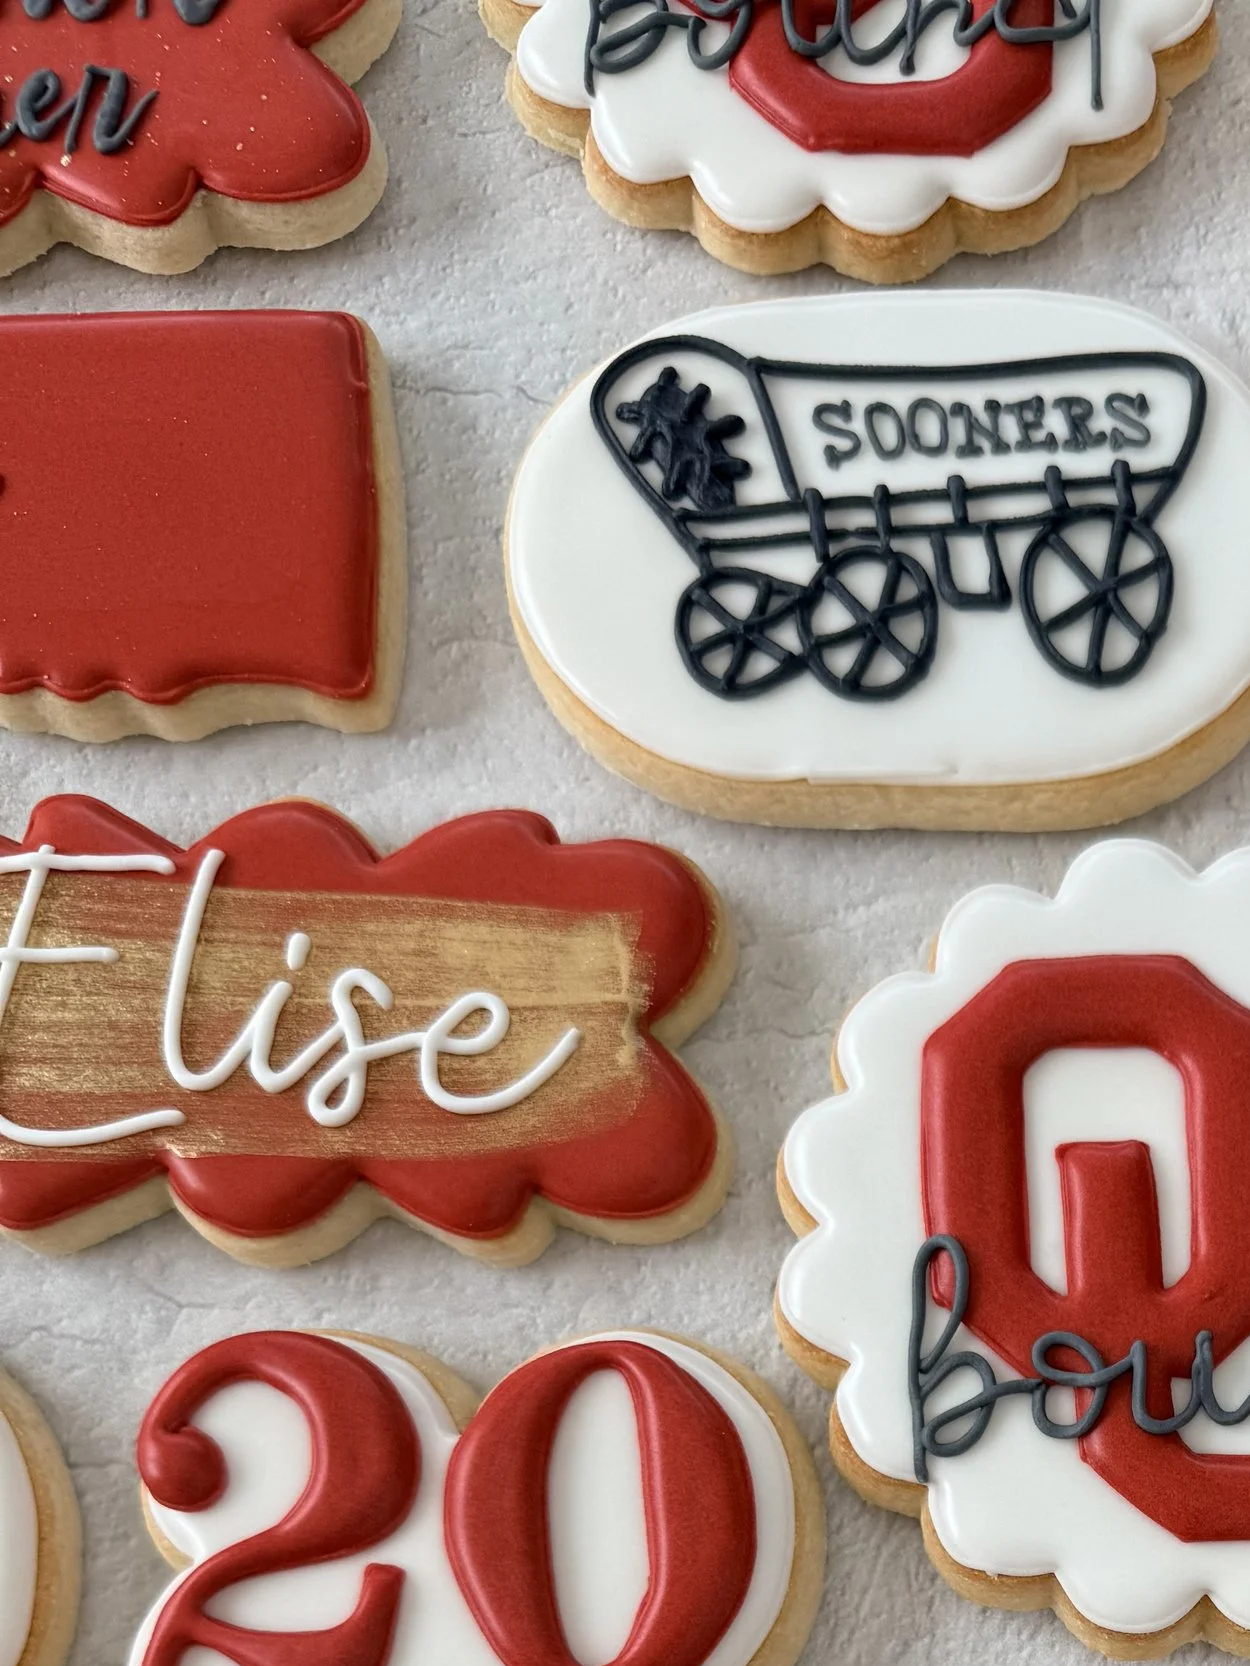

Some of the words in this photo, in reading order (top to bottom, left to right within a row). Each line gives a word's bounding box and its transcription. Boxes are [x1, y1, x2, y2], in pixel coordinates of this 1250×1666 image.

[0, 63, 160, 155] er
[811, 392, 1154, 470] SOONERS
[0, 845, 582, 1148] Elise
